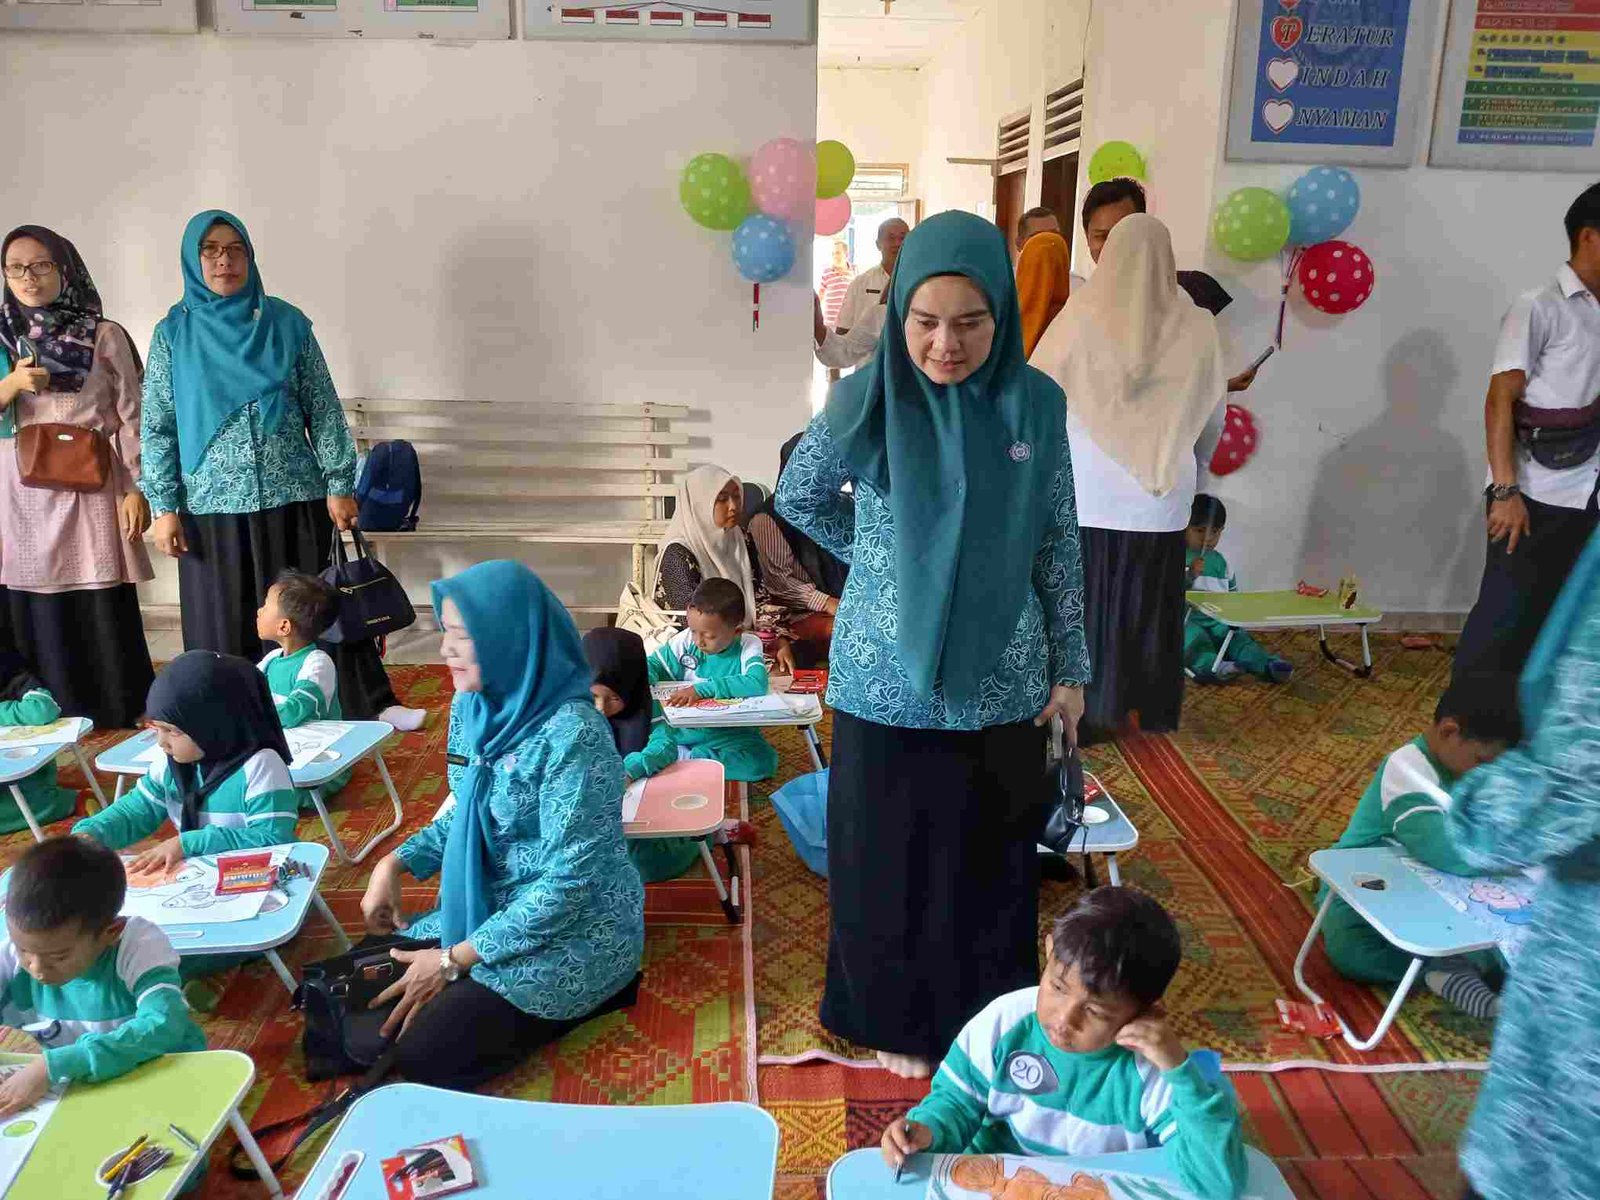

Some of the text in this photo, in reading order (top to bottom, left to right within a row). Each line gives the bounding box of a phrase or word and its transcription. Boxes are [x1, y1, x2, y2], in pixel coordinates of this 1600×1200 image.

[1301, 65, 1391, 89] INDAH
[1296, 107, 1389, 130] NYAMAN
[1012, 1059, 1041, 1084] 20
